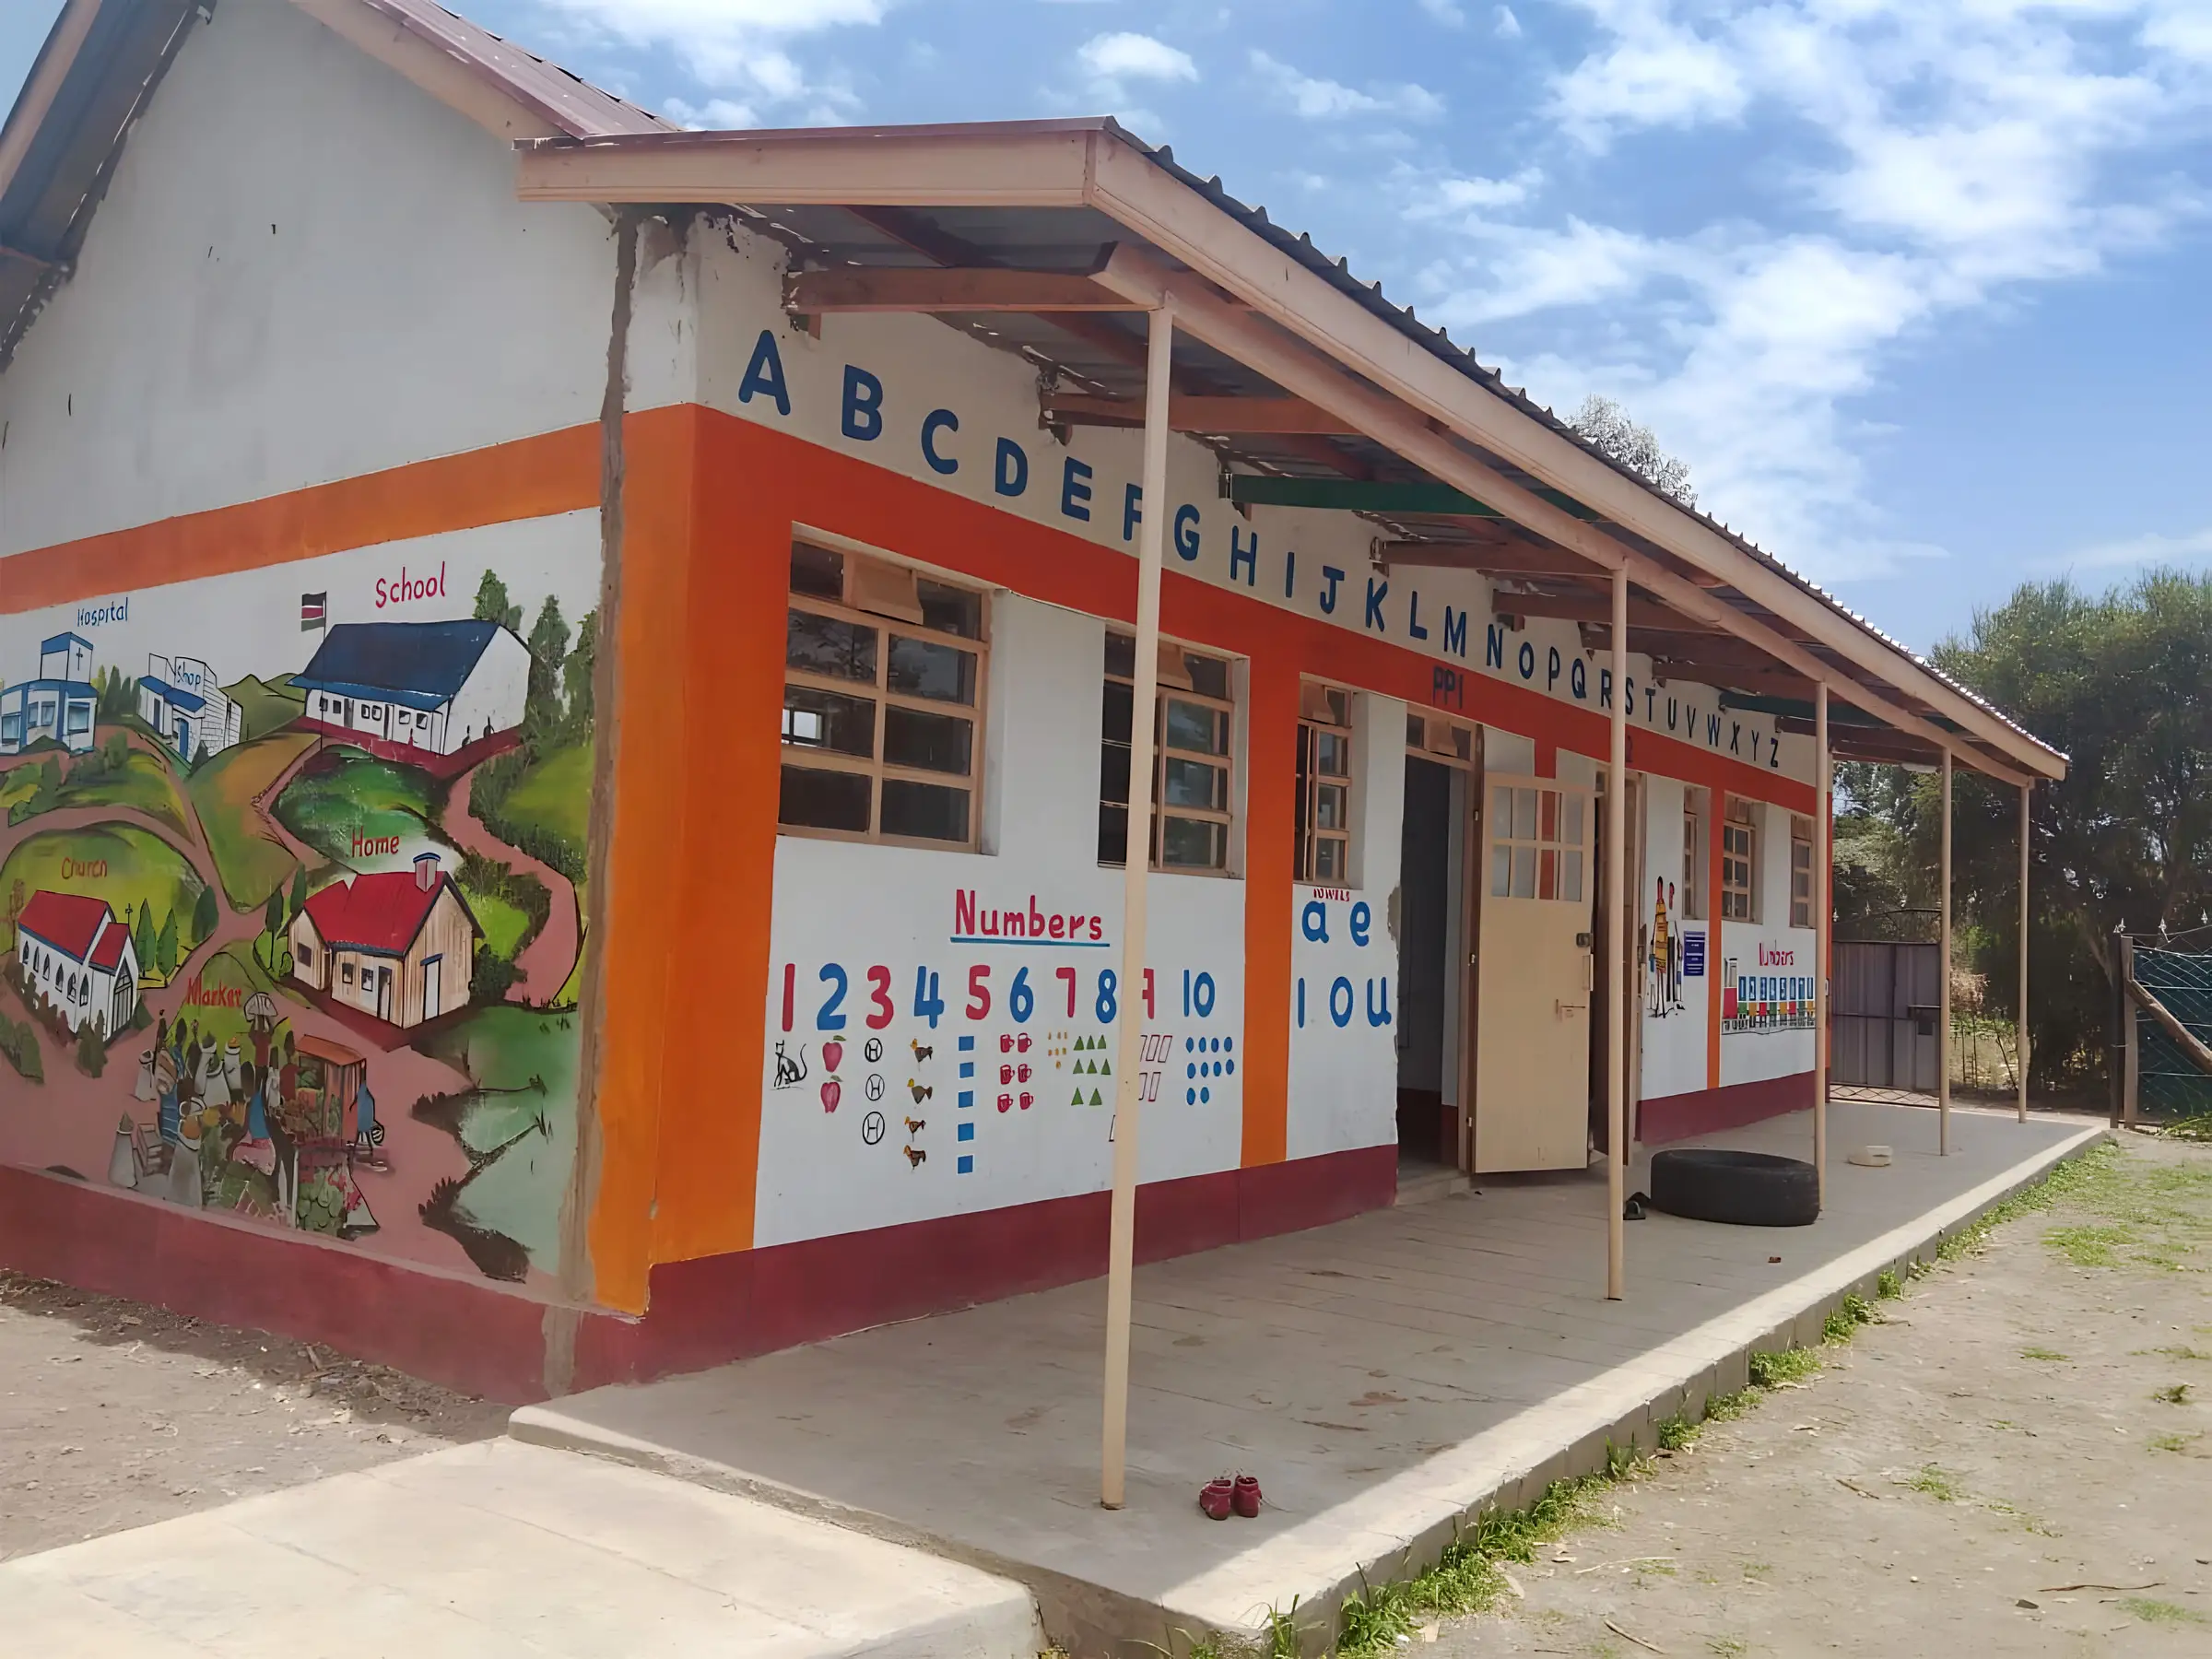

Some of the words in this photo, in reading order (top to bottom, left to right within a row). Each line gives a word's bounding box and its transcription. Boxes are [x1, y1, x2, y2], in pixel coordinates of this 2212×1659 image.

[738, 330, 791, 416] A
[841, 364, 883, 441] B
[921, 408, 959, 475] C
[994, 437, 1029, 497] D
[1062, 456, 1093, 522] E
[1123, 483, 1143, 541] F
[1173, 503, 1201, 561] G
[1230, 524, 1258, 587] H
[1285, 551, 1295, 599] I
[1319, 565, 1346, 615] J
[1365, 572, 1386, 633] K
[1409, 590, 1428, 641] L
[1443, 605, 1468, 658] M
[1486, 624, 1503, 670] N
[1518, 641, 1535, 680] O
[1547, 645, 1561, 692] P
[1571, 657, 1587, 700] Q
[1600, 668, 1612, 711] R
[1625, 677, 1635, 716] S
[1644, 687, 1657, 723] T
[1667, 696, 1677, 731] U
[1686, 703, 1697, 739] V
[1706, 712, 1722, 748] W
[1729, 720, 1741, 756] X
[1750, 729, 1760, 762] Y
[1770, 737, 1779, 769] Z
[375, 560, 446, 609] School
[77, 596, 129, 627] Hospital
[176, 662, 202, 693] Shop
[351, 825, 400, 858] Home
[956, 888, 1103, 941] Numbers
[1301, 900, 1330, 945] a
[1349, 900, 1371, 947] e
[782, 962, 796, 1032] 1
[816, 962, 848, 1031] 2
[865, 965, 895, 1030] 3
[913, 965, 945, 1030] 4
[965, 964, 991, 1020] 5
[1009, 966, 1034, 1024] 6
[1055, 967, 1077, 1018] 7
[1095, 969, 1117, 1024] 8
[1182, 969, 1216, 1018] 10
[1366, 976, 1393, 1028] u
